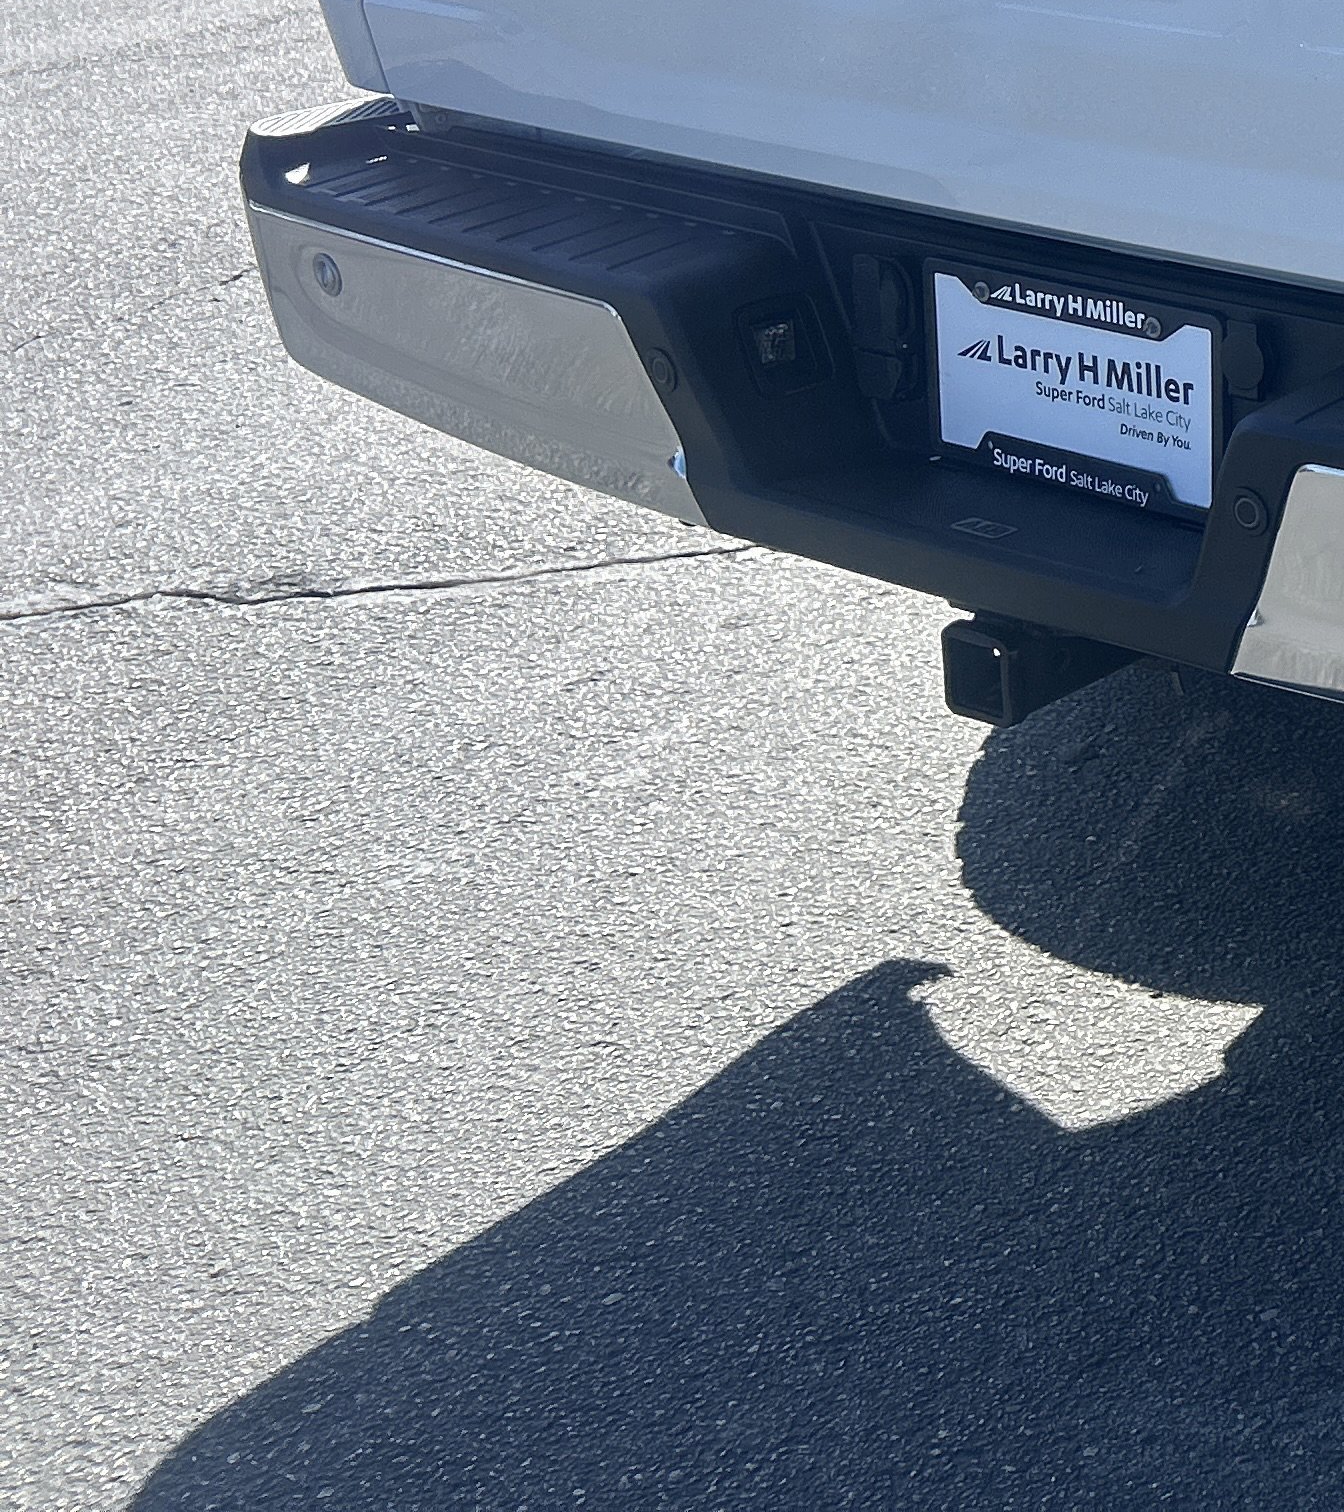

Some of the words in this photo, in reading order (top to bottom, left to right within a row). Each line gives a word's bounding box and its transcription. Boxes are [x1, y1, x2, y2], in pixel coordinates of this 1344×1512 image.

[1014, 283, 1064, 317] Larry
[1067, 294, 1083, 317] H
[1086, 298, 1146, 330] Miller
[997, 334, 1072, 386] Larry
[1078, 352, 1099, 386] H
[1106, 358, 1194, 406] Miller
[1035, 381, 1073, 404] Super
[1076, 390, 1106, 410] Ford
[1108, 396, 1131, 417] Salt
[1133, 402, 1164, 424] Lake
[1166, 410, 1192, 433] City
[1120, 423, 1154, 442] Driven
[1157, 431, 1170, 448] By
[993, 448, 1033, 475] Super
[1035, 458, 1066, 483] Ford
[1070, 470, 1093, 491] Salt
[1095, 475, 1123, 498] Lake
[1125, 484, 1150, 508] City
